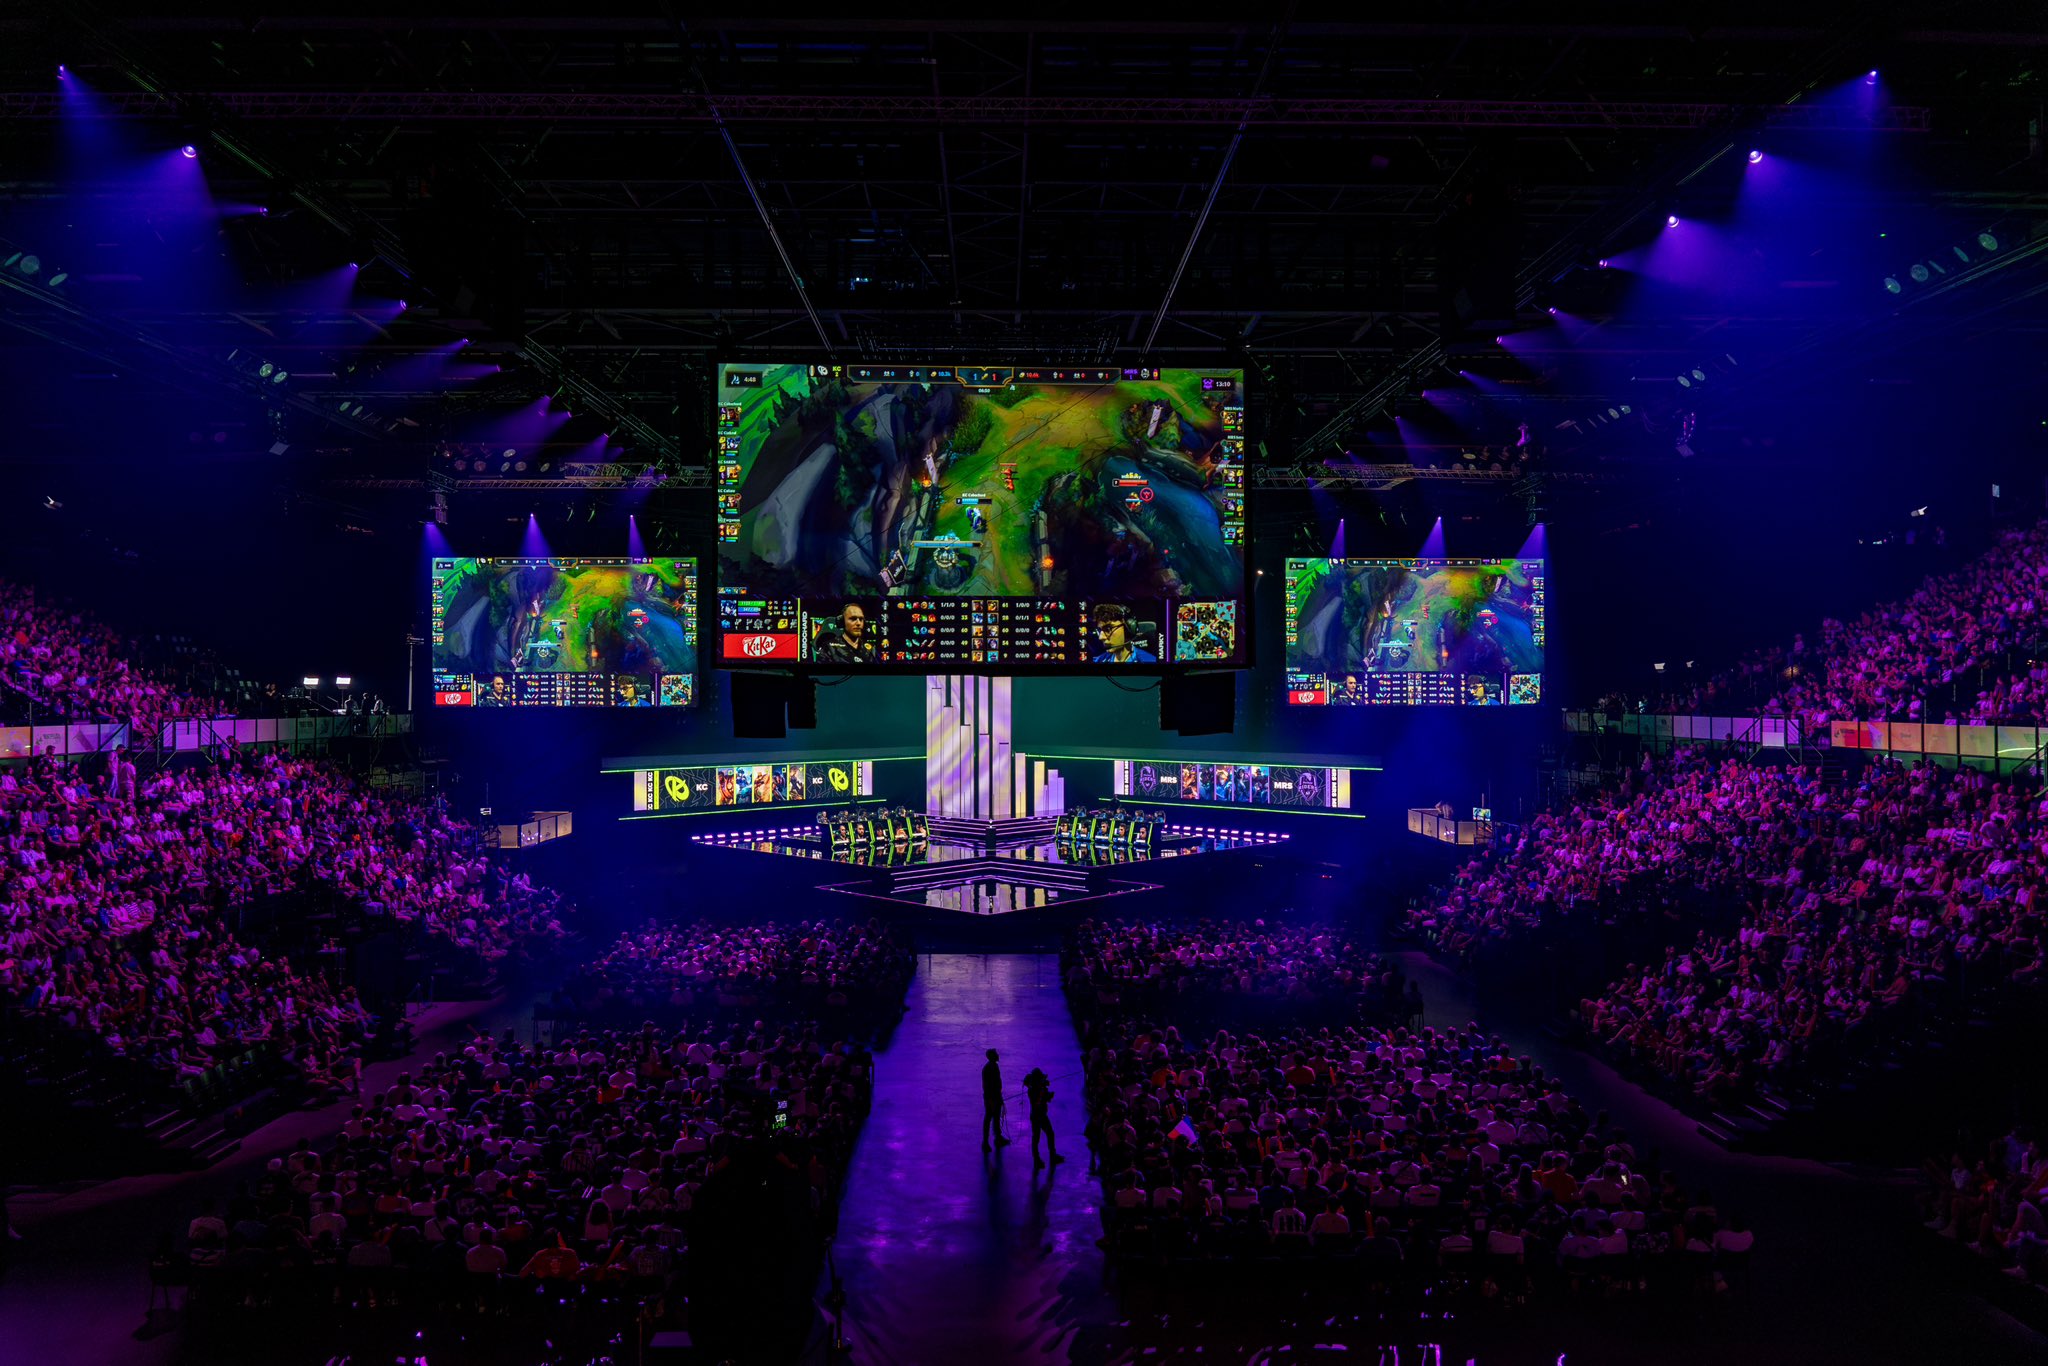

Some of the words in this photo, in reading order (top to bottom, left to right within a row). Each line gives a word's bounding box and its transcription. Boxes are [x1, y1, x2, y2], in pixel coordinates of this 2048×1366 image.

[747, 637, 776, 656] KitKat
[647, 772, 653, 782] KC
[812, 777, 823, 785] KC
[1160, 776, 1178, 784] MRS
[696, 783, 709, 791] KC
[1273, 781, 1294, 790] MRS
